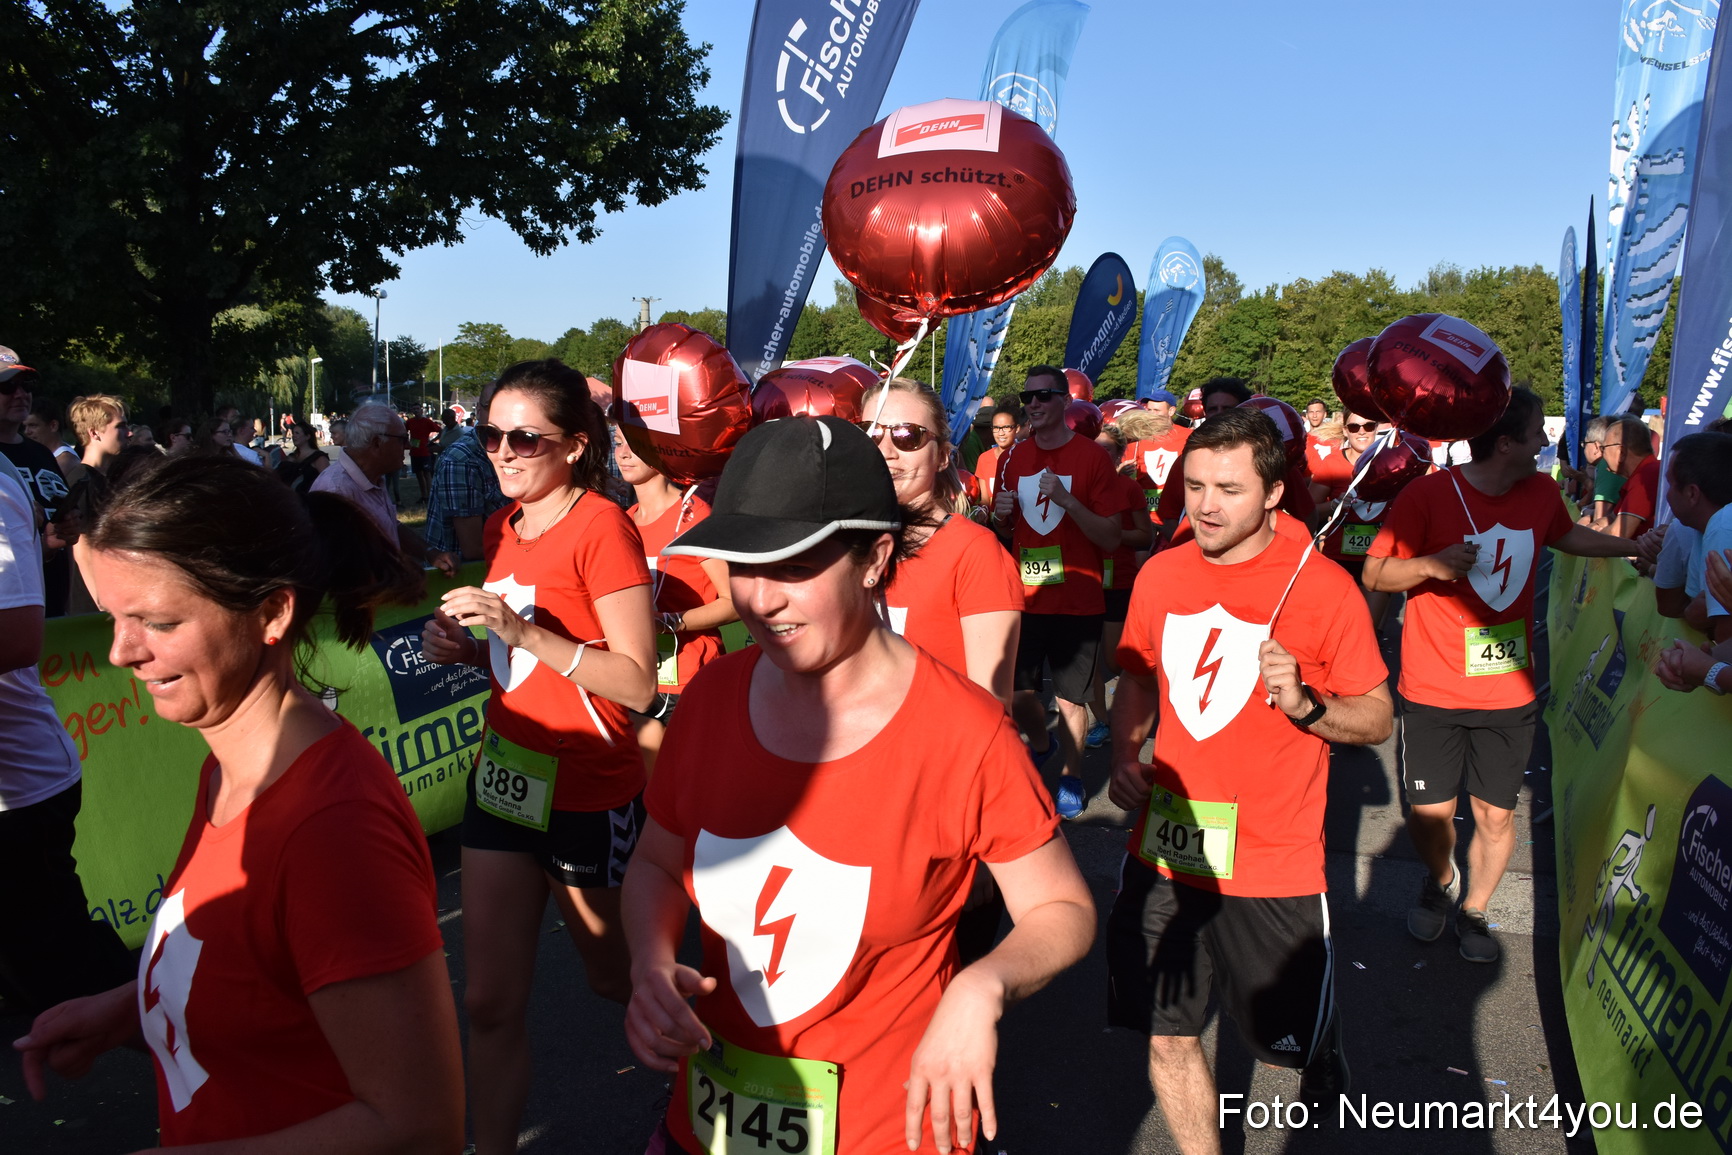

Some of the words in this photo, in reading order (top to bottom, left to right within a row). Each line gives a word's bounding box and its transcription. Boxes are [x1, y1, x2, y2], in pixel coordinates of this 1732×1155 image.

[836, 0, 881, 99] AUTOMOB
[920, 119, 960, 135] DEHN
[851, 170, 913, 198] DEHN
[1394, 341, 1430, 361] DEHN
[1447, 335, 1471, 348] DEHN
[640, 402, 657, 412] DEHN
[1349, 535, 1371, 547] 420
[1025, 560, 1051, 575] 394
[1481, 640, 1516, 661] 432
[361, 697, 490, 777] irme
[483, 760, 528, 802] 389
[1414, 780, 1426, 790] TR
[483, 788, 498, 801] Meier
[499, 797, 522, 811] Hanna
[1156, 819, 1205, 855] 401
[552, 855, 598, 874] hummel
[1173, 850, 1205, 863] Raphael
[1689, 866, 1728, 911] AUTOMOBILE
[1597, 979, 1654, 1079] neumarkt
[1270, 1043, 1301, 1052] adidas
[743, 1082, 774, 1097] 2018
[697, 1075, 808, 1154] 2145
